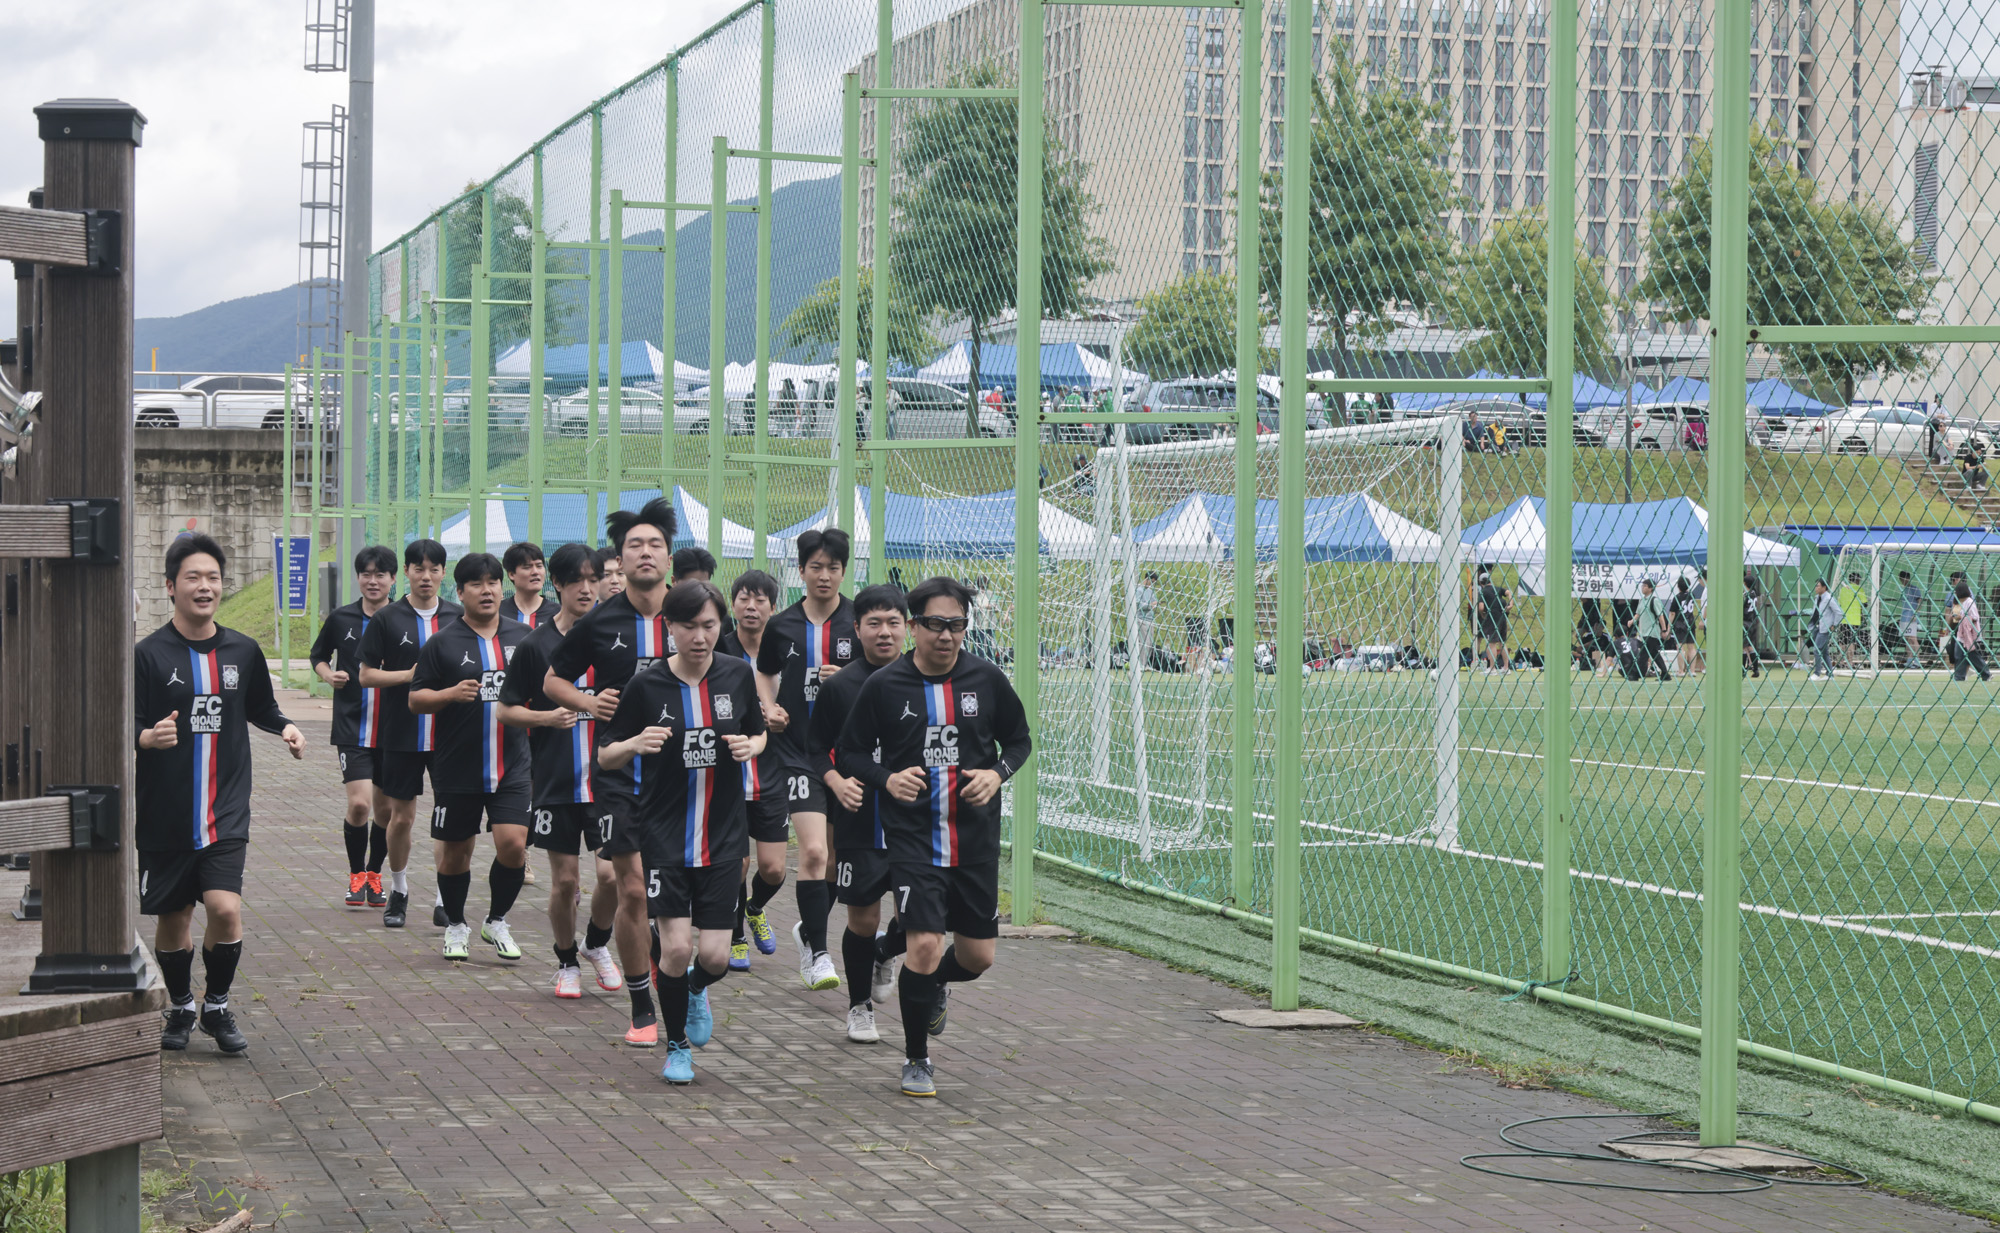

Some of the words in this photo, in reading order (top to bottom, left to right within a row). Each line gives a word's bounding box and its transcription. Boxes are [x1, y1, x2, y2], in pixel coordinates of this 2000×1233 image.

[1572, 579, 1613, 593] 강화력
[481, 671, 506, 687] FC
[191, 695, 222, 715] FC
[190, 715, 222, 733] 일요신문
[683, 728, 716, 750] FC
[924, 725, 959, 747] FC
[683, 749, 716, 768] 일요신문
[923, 746, 959, 767] 일요신문
[787, 775, 809, 800] 28
[435, 806, 446, 829] 11
[534, 809, 552, 835] 18
[598, 814, 614, 842] 27
[648, 869, 661, 898] 5
[837, 861, 852, 888] 16
[899, 886, 910, 913] 7
